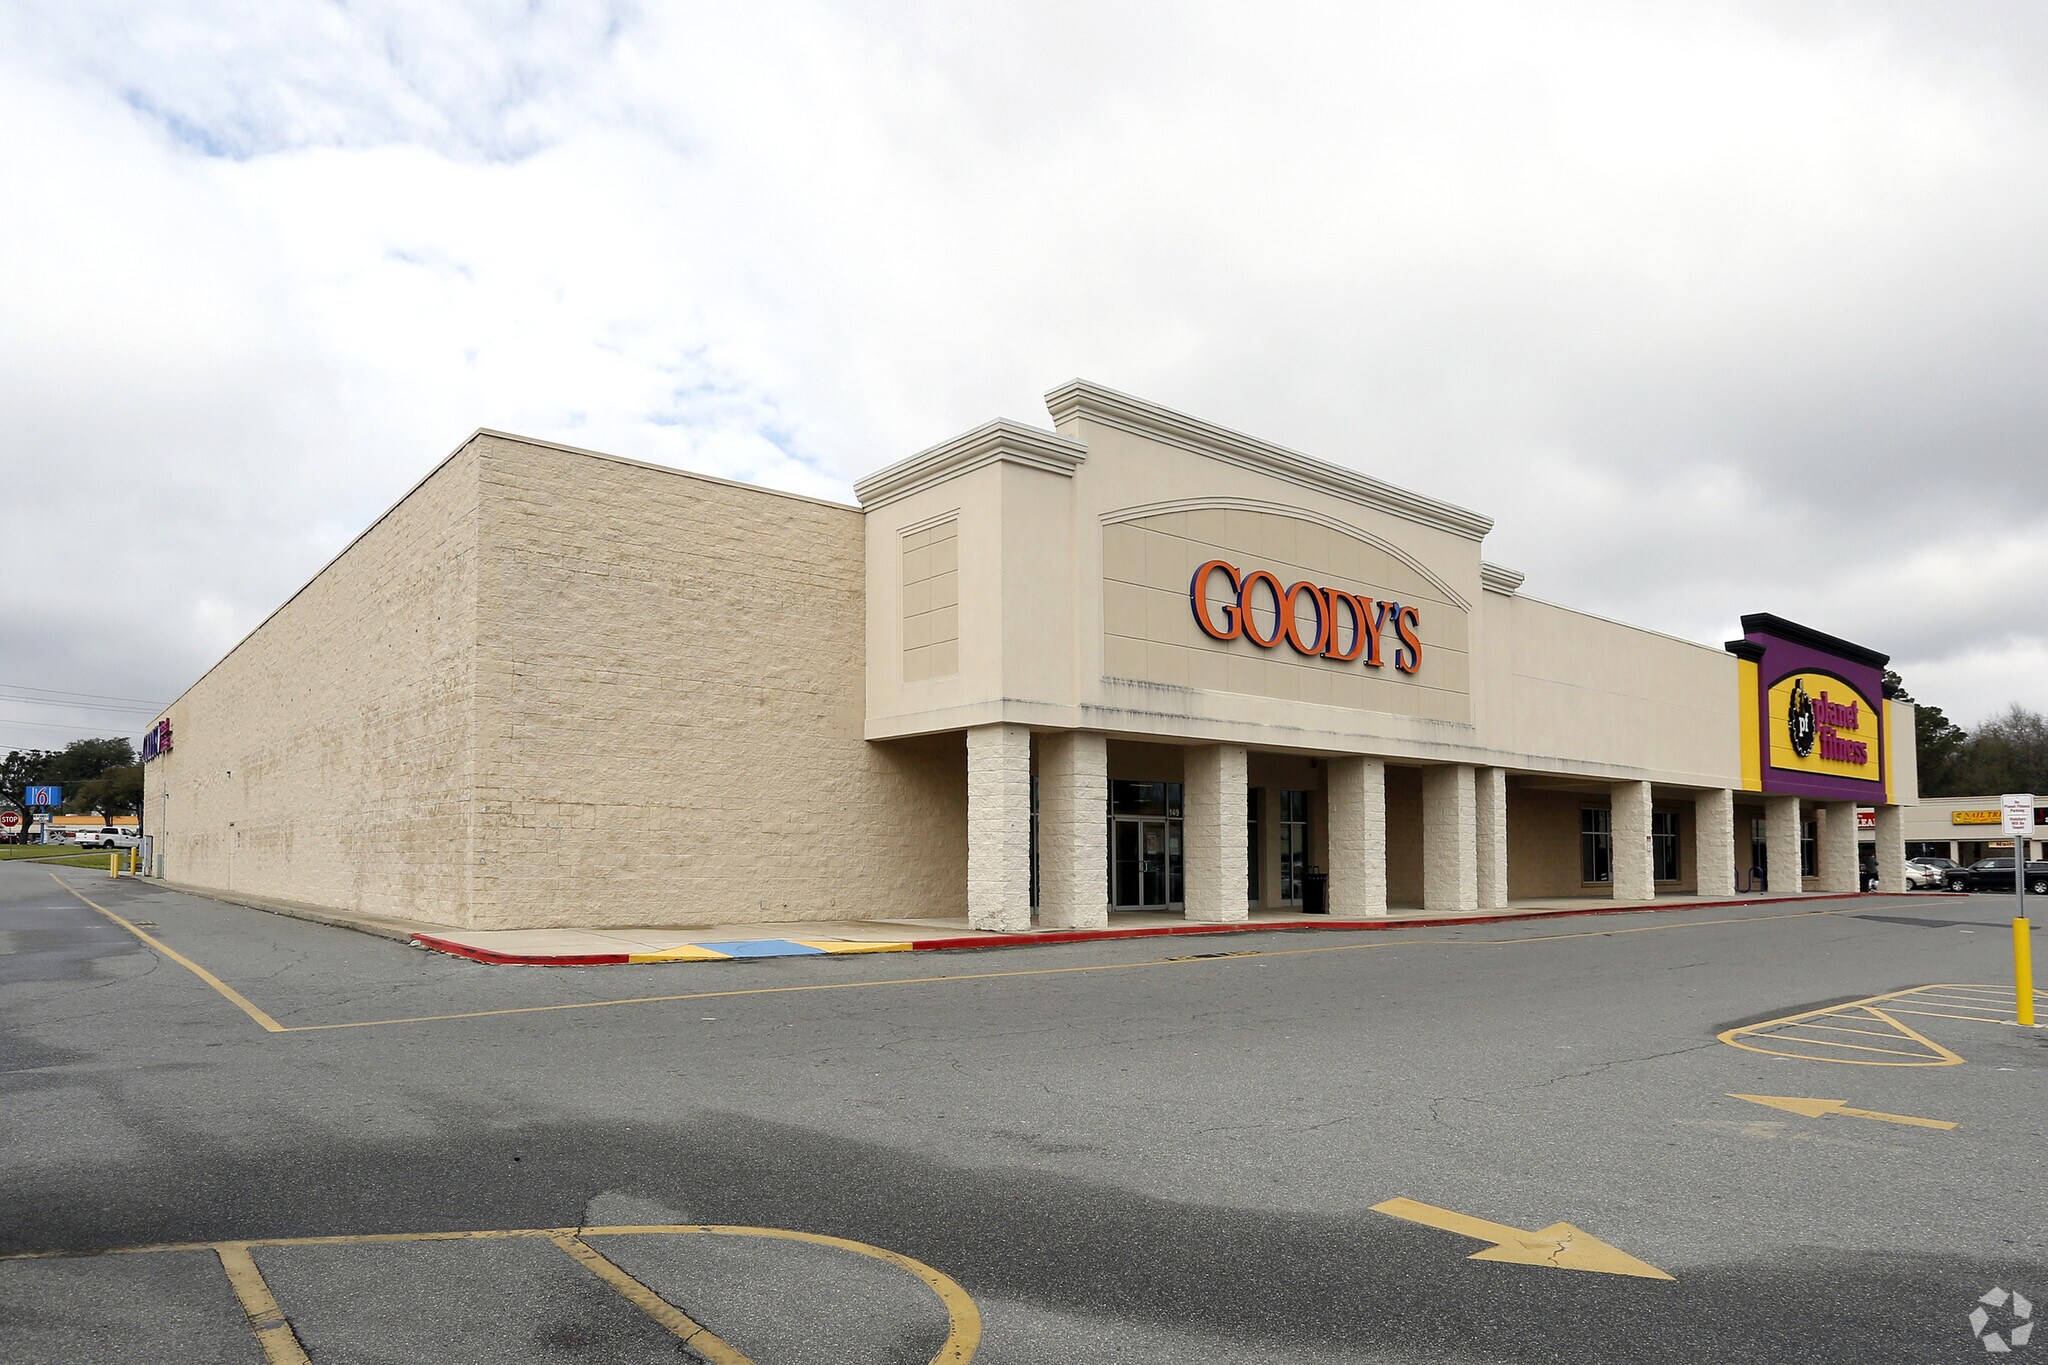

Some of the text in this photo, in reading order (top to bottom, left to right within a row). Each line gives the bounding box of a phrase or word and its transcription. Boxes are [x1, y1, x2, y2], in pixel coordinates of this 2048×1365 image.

[1190, 560, 1422, 674] GOODY'S
[1798, 712, 1809, 737] pf
[1812, 691, 1859, 733] planet
[1819, 727, 1868, 765] fitness
[36, 787, 48, 806] 6
[1169, 808, 1180, 816] 149
